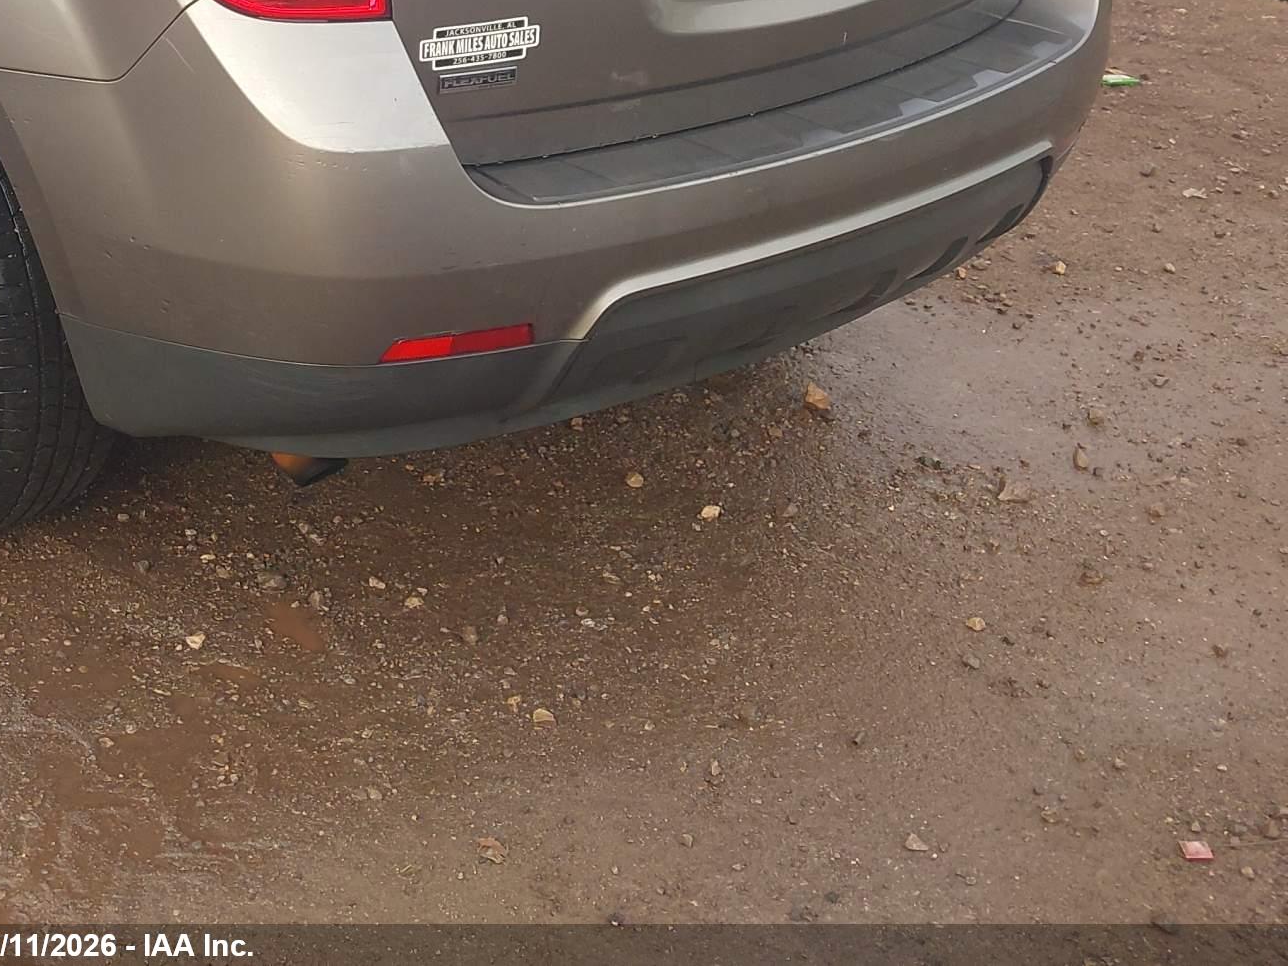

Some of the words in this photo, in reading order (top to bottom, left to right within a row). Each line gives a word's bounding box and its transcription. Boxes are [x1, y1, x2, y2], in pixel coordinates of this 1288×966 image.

[423, 40, 455, 58] FRANK
[456, 37, 484, 54] MILES
[484, 34, 508, 50] AUTO
[509, 28, 536, 46] SALES
